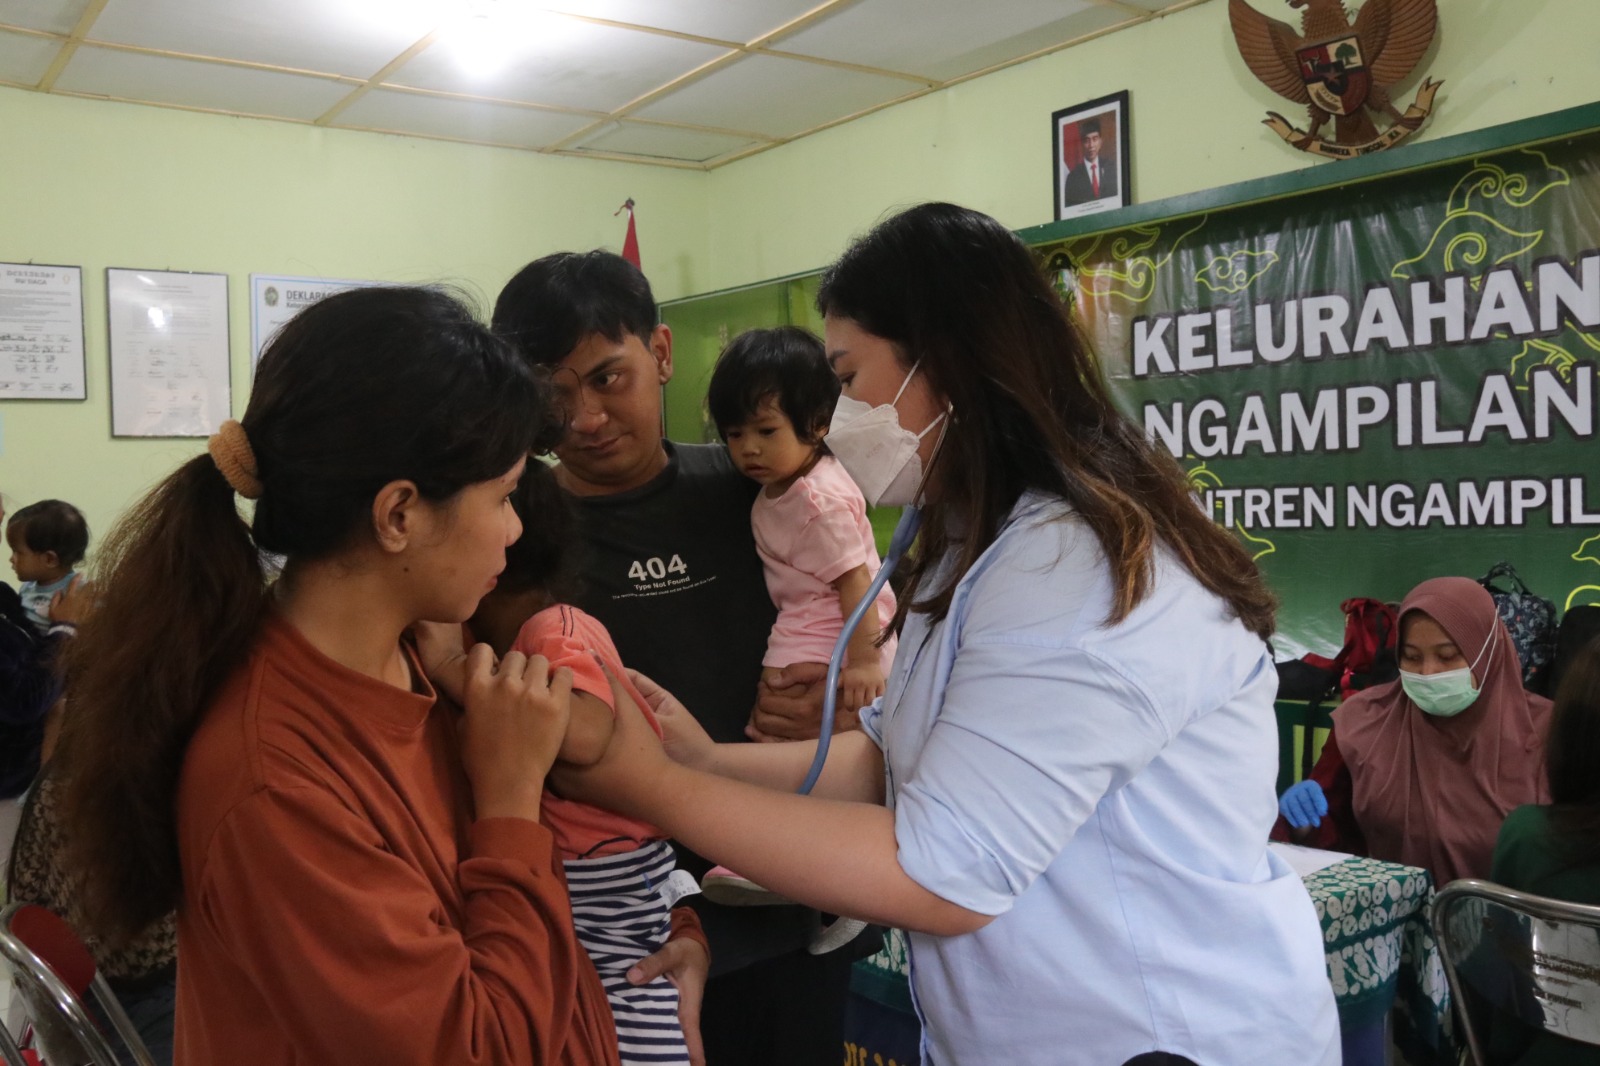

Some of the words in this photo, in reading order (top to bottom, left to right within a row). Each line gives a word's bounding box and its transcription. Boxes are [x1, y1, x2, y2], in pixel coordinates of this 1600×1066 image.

[1134, 255, 1600, 375] KELURAHAN
[1144, 366, 1592, 458] NGAMPILAN
[1347, 478, 1600, 527] NGAMPIL
[628, 553, 688, 581] 404
[652, 580, 667, 589] Not
[667, 575, 691, 586] Found
